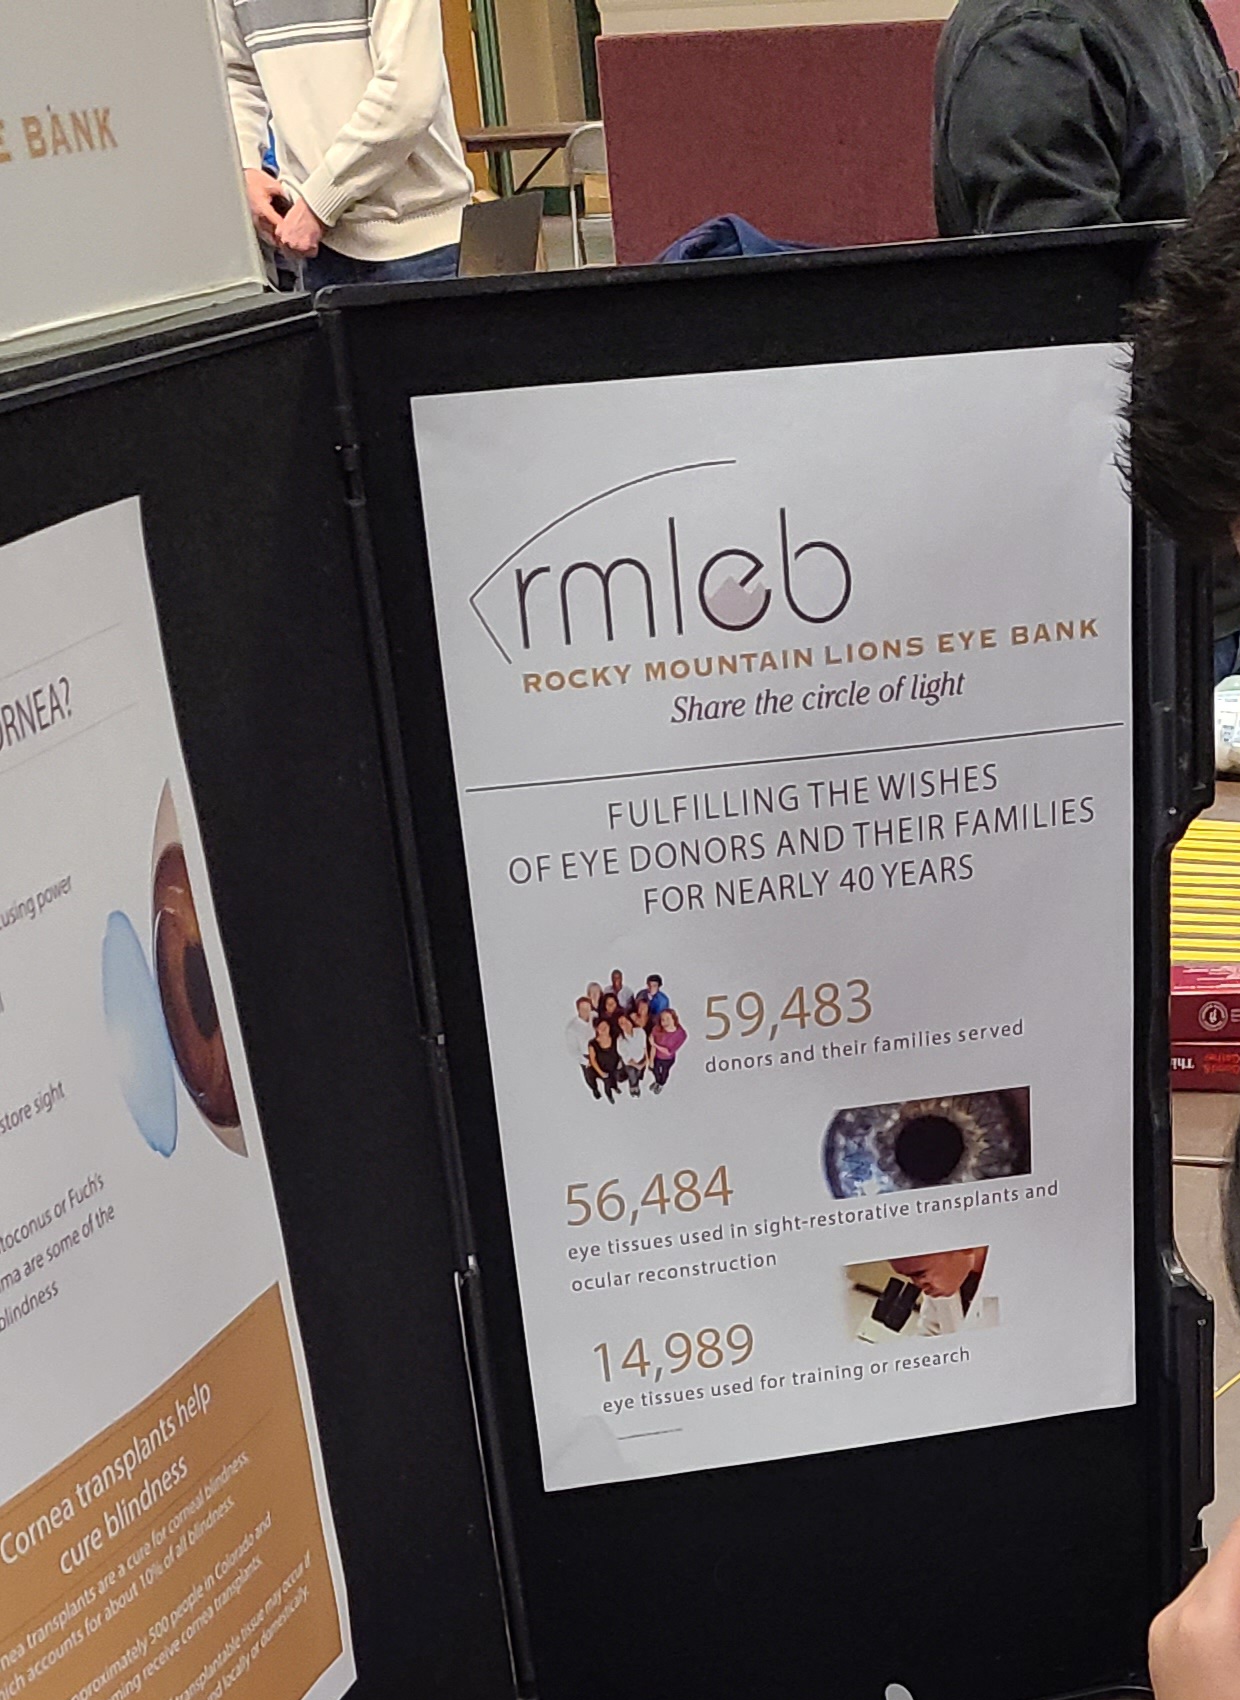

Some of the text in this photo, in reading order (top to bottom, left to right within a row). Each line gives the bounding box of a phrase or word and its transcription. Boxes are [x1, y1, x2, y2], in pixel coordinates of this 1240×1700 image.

[21, 107, 118, 159] BANK
[515, 508, 852, 649] rmleb
[523, 619, 1098, 693] ROCKY MOUNTAIN LIONS EYE BANK
[671, 671, 965, 723] Share the circle of light
[609, 764, 996, 829] FULFILLING THE WISHES
[510, 797, 1093, 884] OF EYE DONORS AND THEIR FAMILIES
[0, 876, 71, 930] using power
[645, 854, 972, 914] FOR NEARLY 40 YEARS
[706, 979, 871, 1041] 59,483
[706, 1019, 1022, 1072] donors and their families served
[34, 1081, 65, 1114] sight
[0, 1173, 105, 1254] toconus or Fuch's
[567, 1166, 733, 1226] 56,484
[569, 1180, 1057, 1262] eye tissues used in sight-restorative transplants and
[23, 1204, 116, 1278] are some of the
[572, 1254, 776, 1291] ocular reconstruction
[594, 1324, 753, 1383] 14,989
[604, 1346, 969, 1415] eye tissues used for training or research
[0, 1382, 211, 1564] Cornea transplants help
[59, 1456, 188, 1574] cure blindness
[26, 1586, 96, 1649] transplants
[98, 1570, 116, 1595] are
[118, 1563, 126, 1578] a
[127, 1541, 151, 1570] cure
[151, 1526, 166, 1547] for
[27, 1629, 84, 1682] accounts
[84, 1614, 102, 1636] for
[105, 1583, 139, 1621] about
[139, 1562, 163, 1589] 10%
[163, 1544, 174, 1568] of
[176, 1535, 187, 1558] all
[148, 1616, 169, 1645] 500
[169, 1584, 204, 1628] people
[204, 1573, 215, 1591] in
[214, 1532, 254, 1580] Colorado
[254, 1510, 271, 1540] and
[142, 1638, 181, 1680] receive
[181, 1606, 214, 1644] cornea
[222, 1651, 250, 1690] locally
[250, 1641, 260, 1660] or
